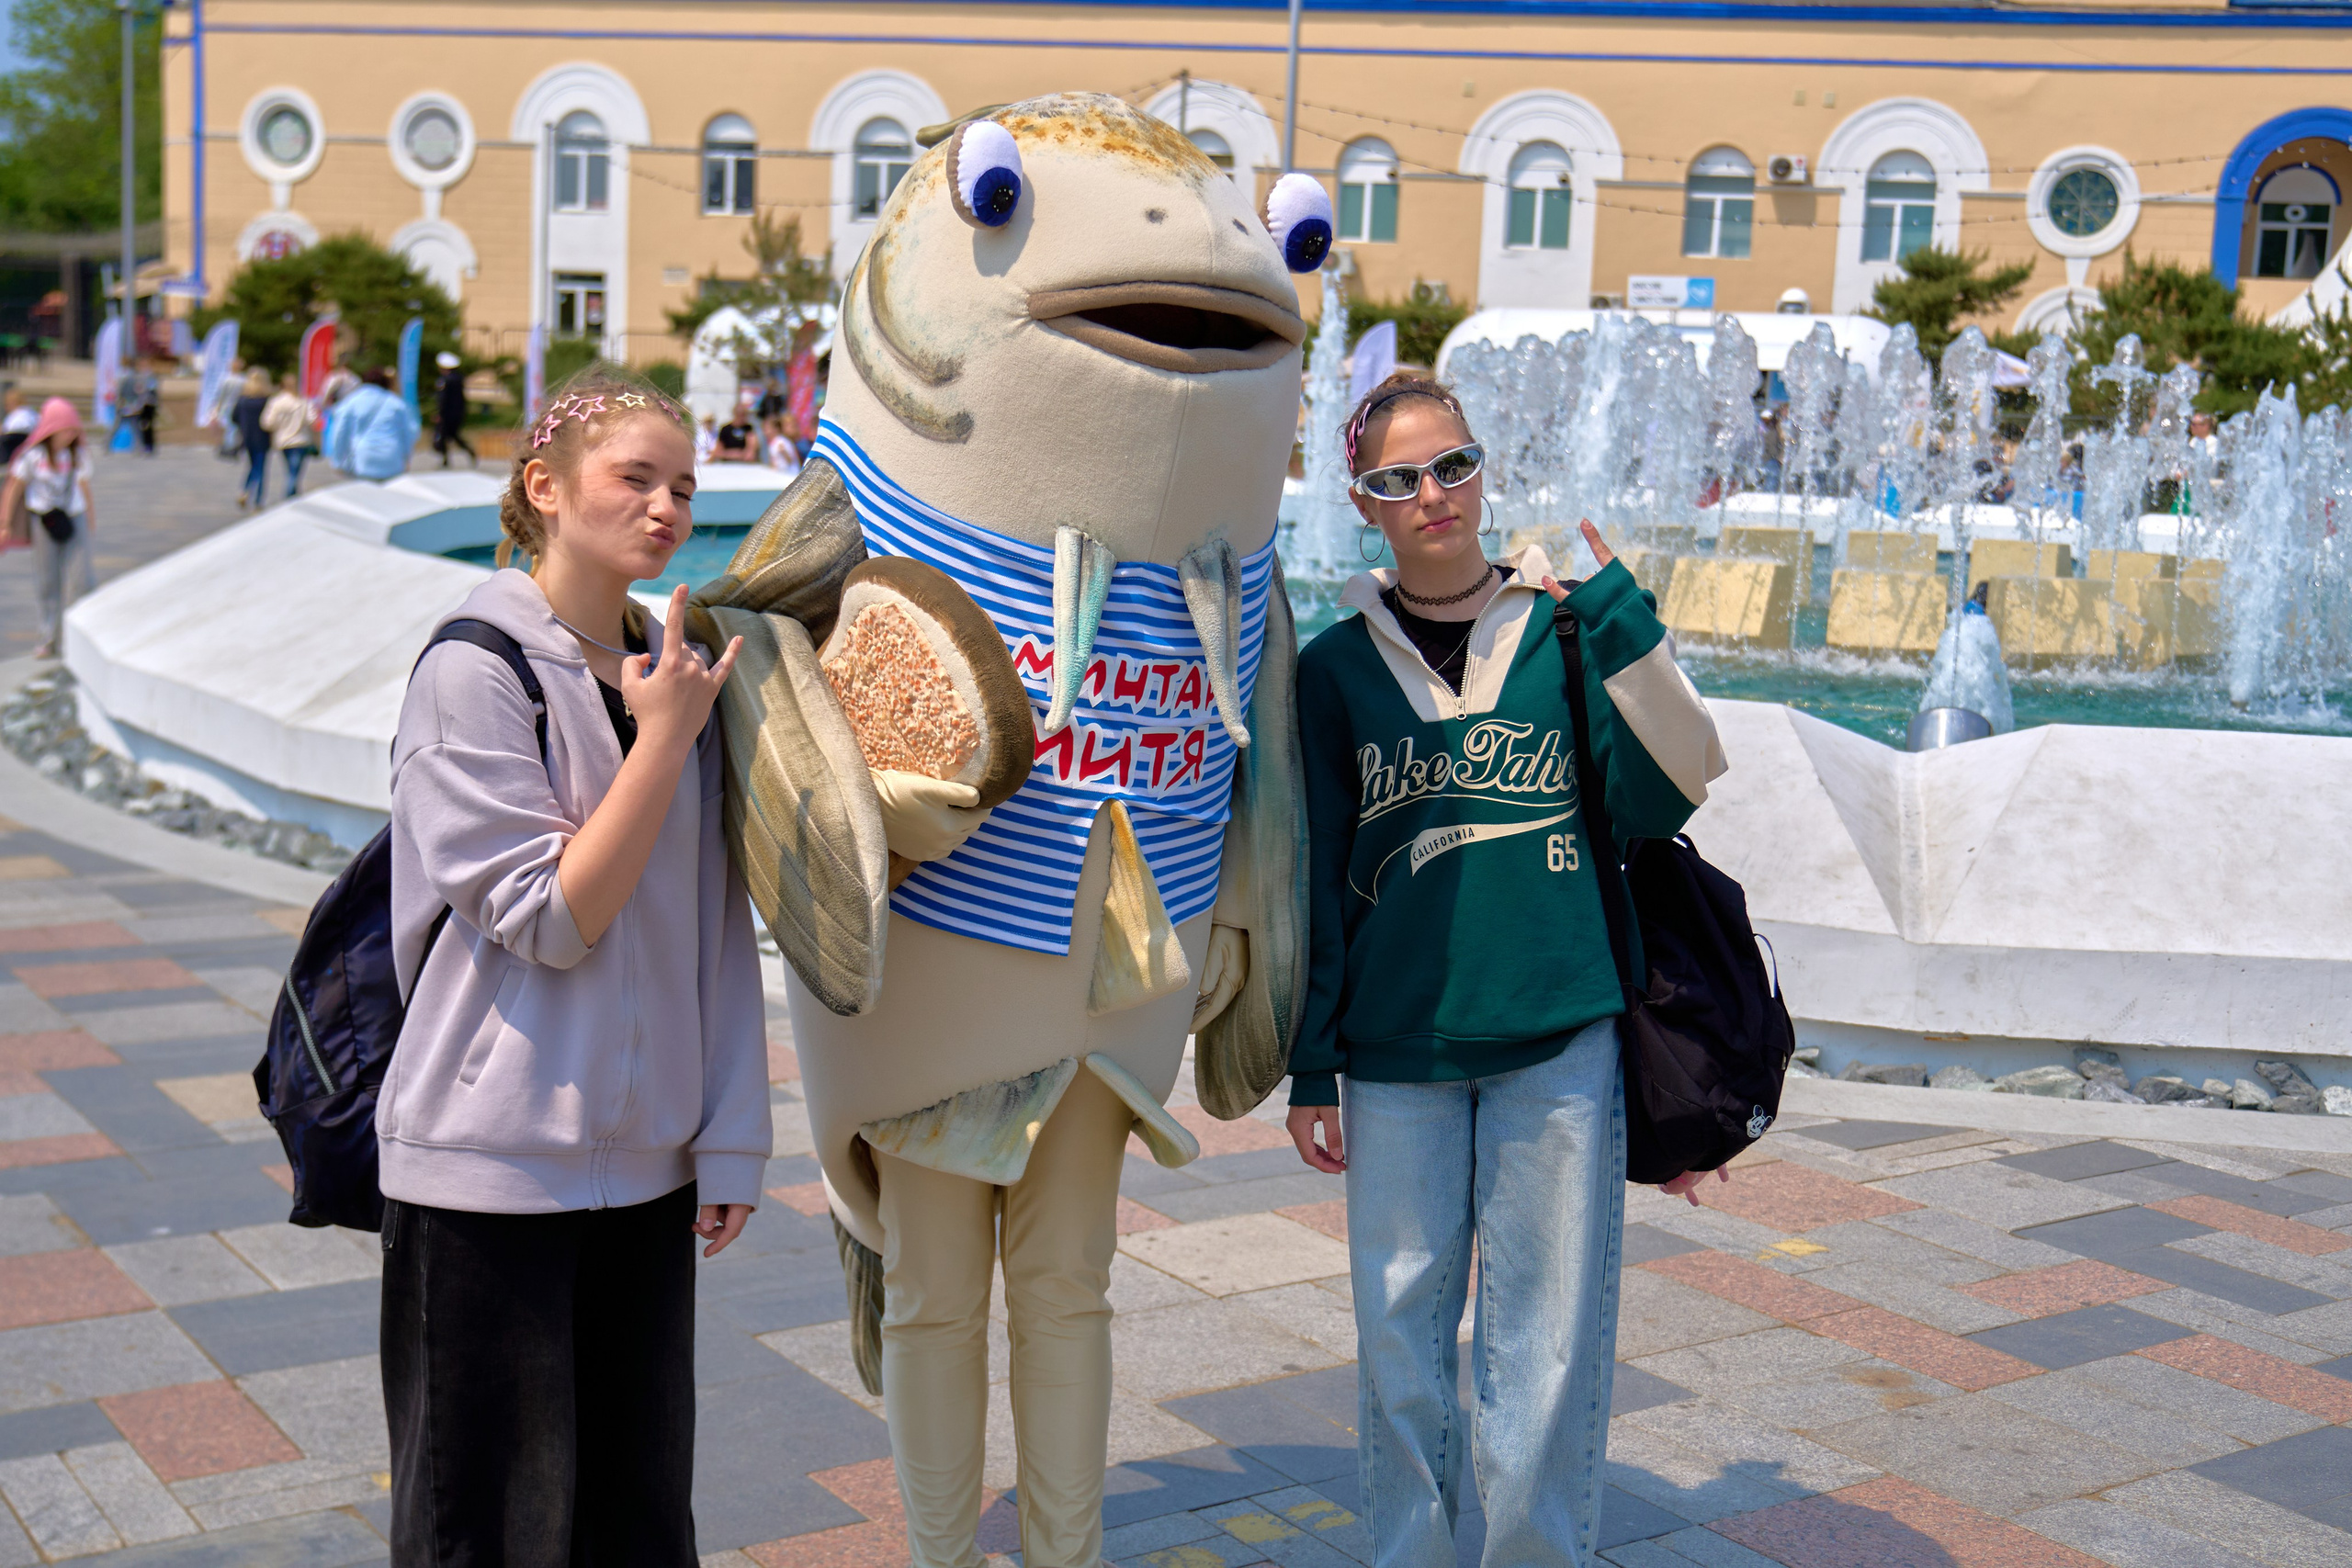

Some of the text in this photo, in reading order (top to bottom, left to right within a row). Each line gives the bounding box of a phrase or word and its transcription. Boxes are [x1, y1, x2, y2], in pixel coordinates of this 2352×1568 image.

[1014, 640, 1215, 712] МИНТА
[1033, 724, 1205, 792] МИТЯ
[1356, 719, 1578, 818] Lake Taho
[1412, 827, 1476, 861] CALIFORNIA
[1547, 833, 1579, 872] 65
